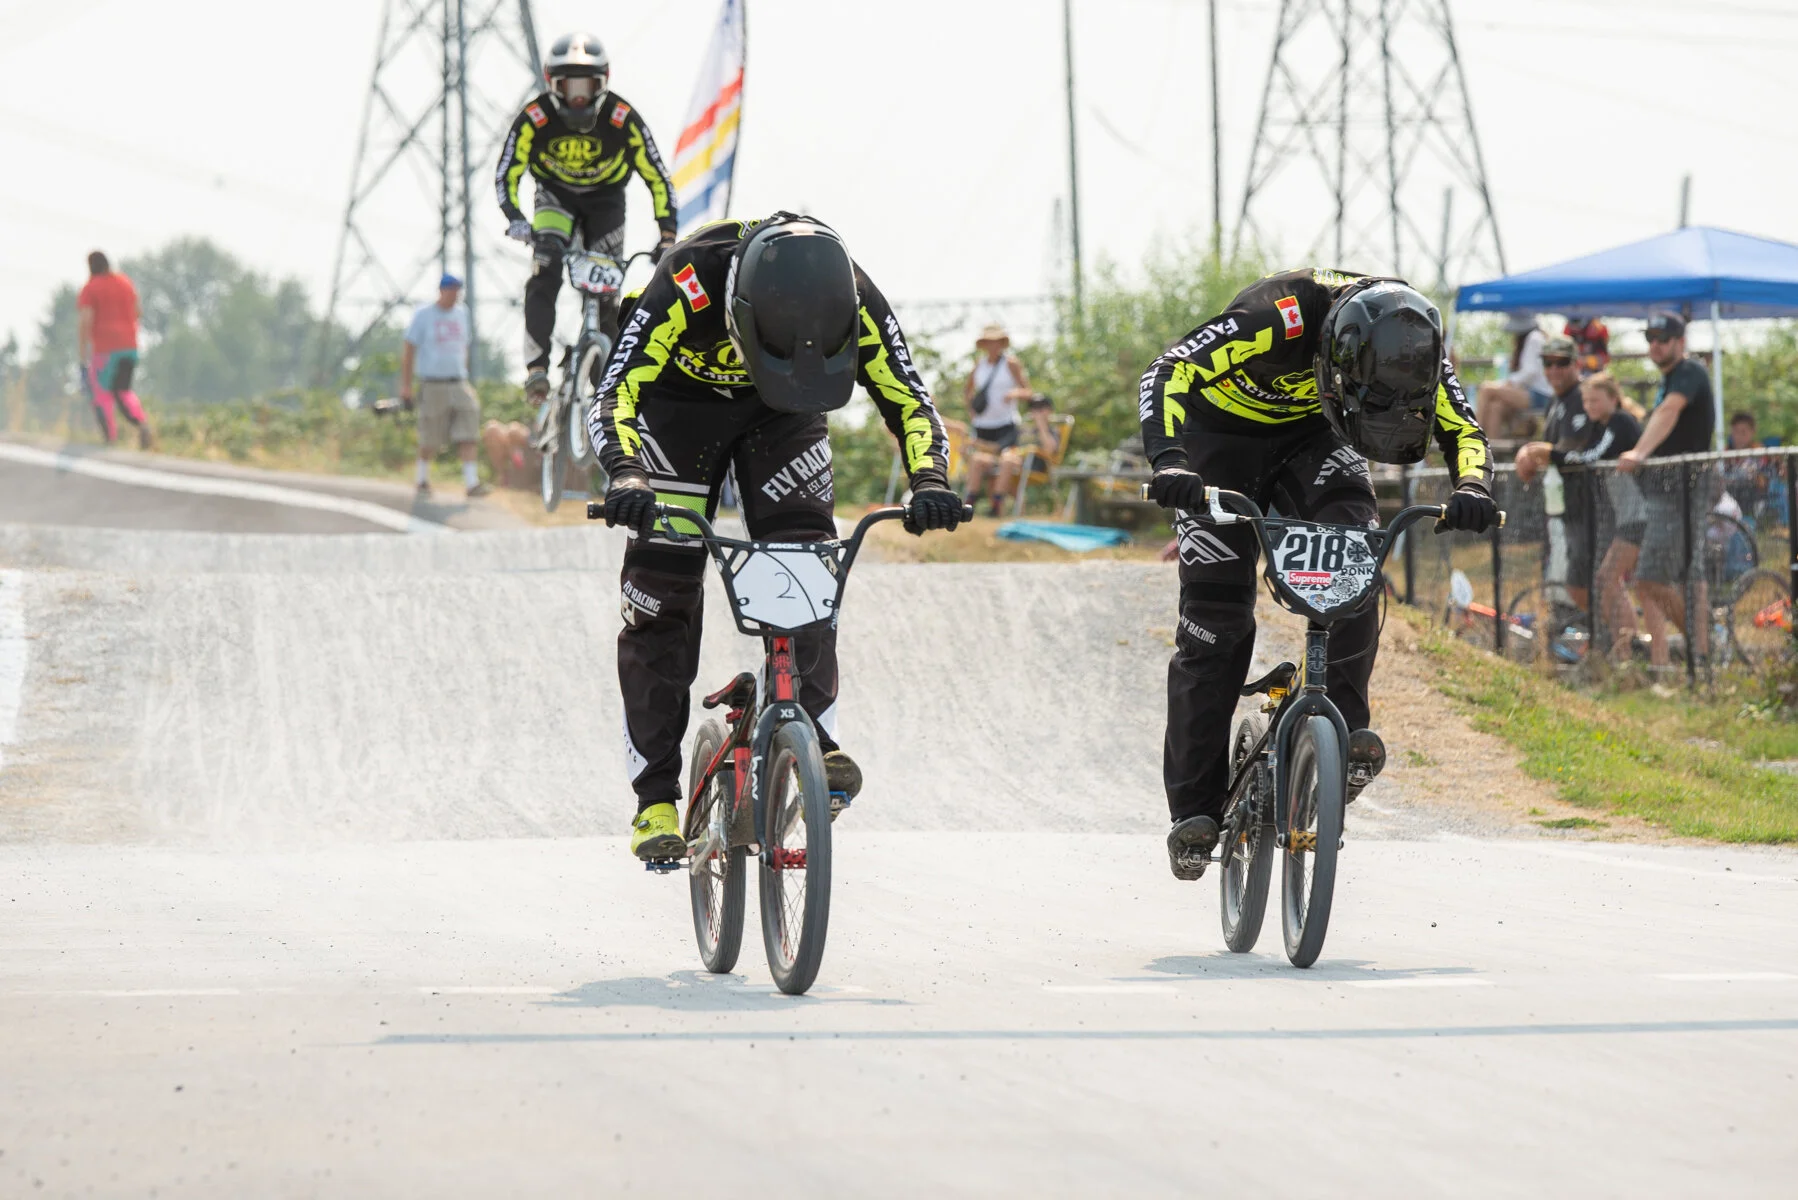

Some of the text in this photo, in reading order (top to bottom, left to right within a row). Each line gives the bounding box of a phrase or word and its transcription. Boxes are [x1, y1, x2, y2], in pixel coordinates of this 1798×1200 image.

[761, 435, 833, 503] FLY RACIN
[1313, 457, 1341, 485] FLY
[1282, 533, 1347, 572] 218
[774, 571, 797, 599] 2
[630, 587, 662, 612] RACING
[1187, 621, 1217, 645] RACING
